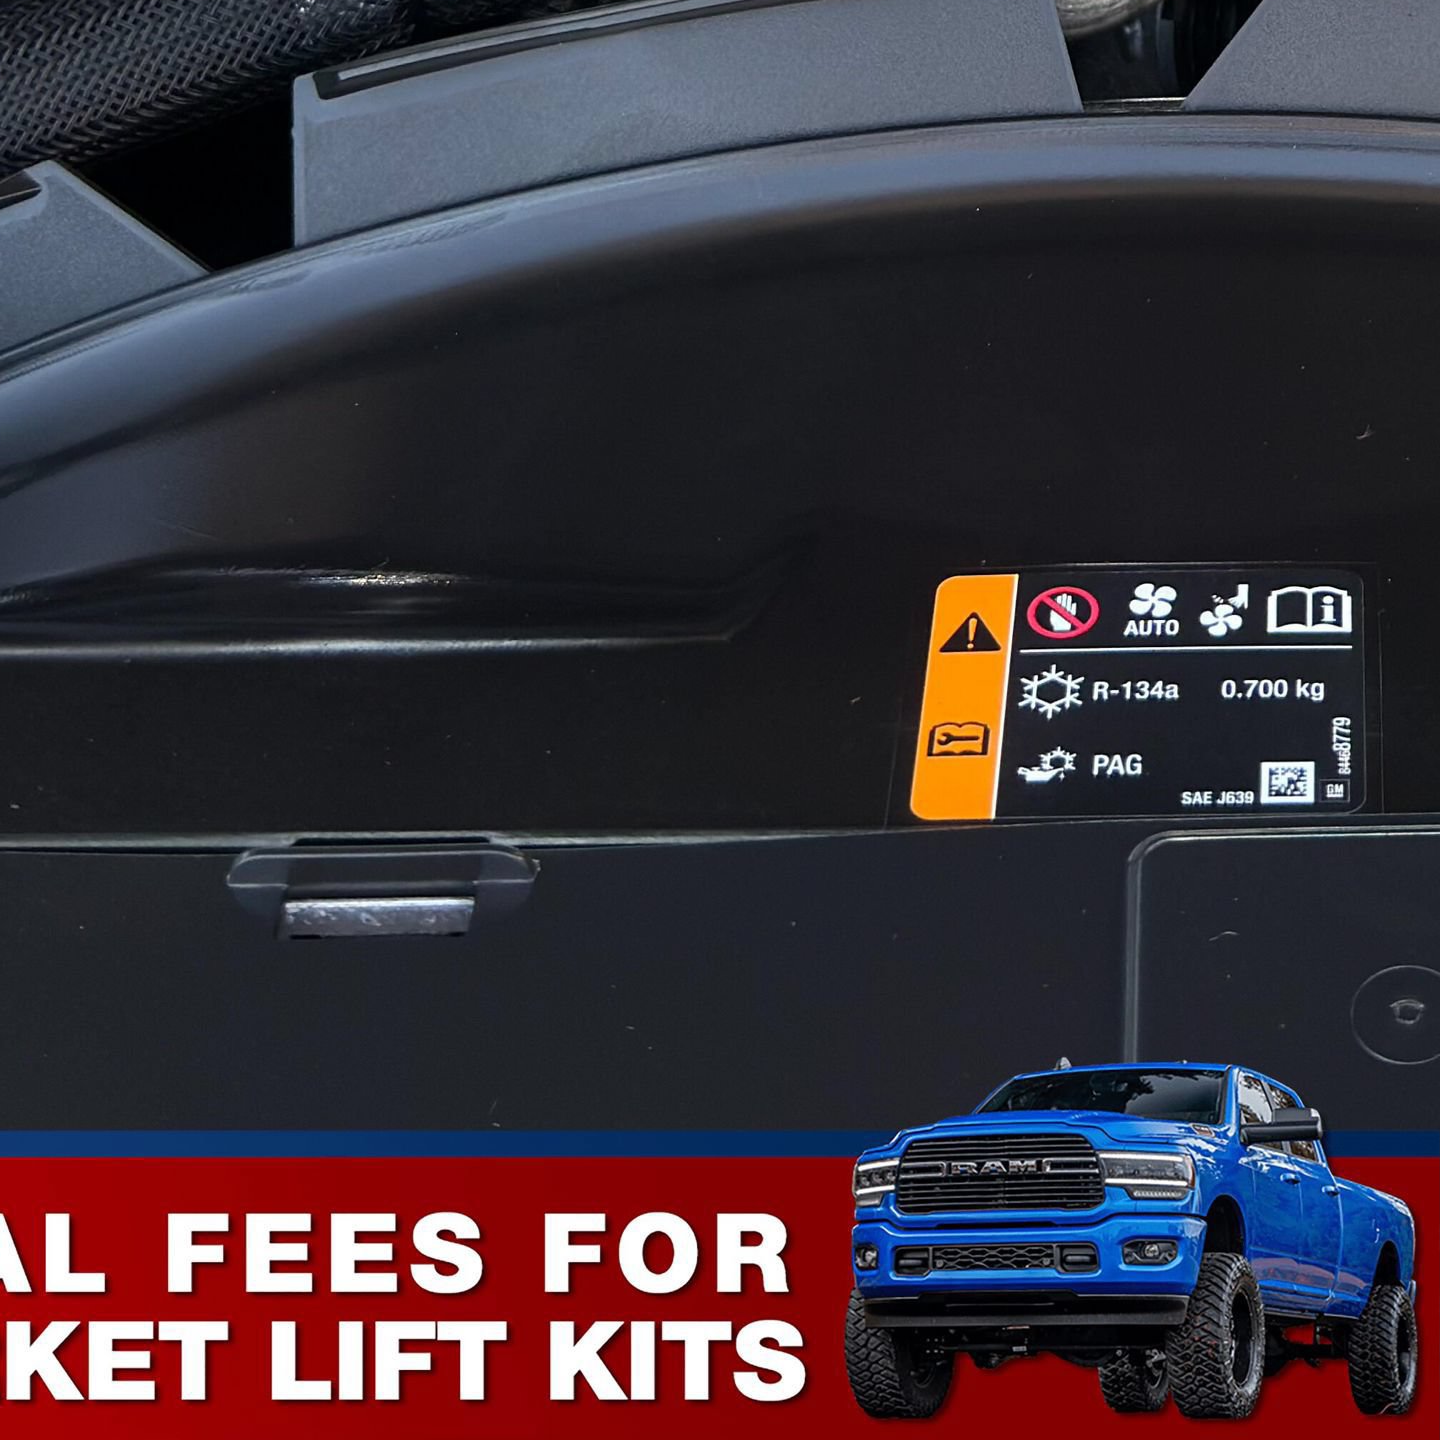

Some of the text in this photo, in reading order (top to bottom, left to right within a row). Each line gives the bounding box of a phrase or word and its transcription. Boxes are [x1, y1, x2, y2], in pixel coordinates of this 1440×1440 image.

[1123, 618, 1180, 637] AUTO
[1092, 678, 1325, 702] R-134a 0.700 kg
[1092, 753, 1143, 776] PAG
[1180, 790, 1255, 806] SAE J639
[1326, 783, 1345, 798] GM
